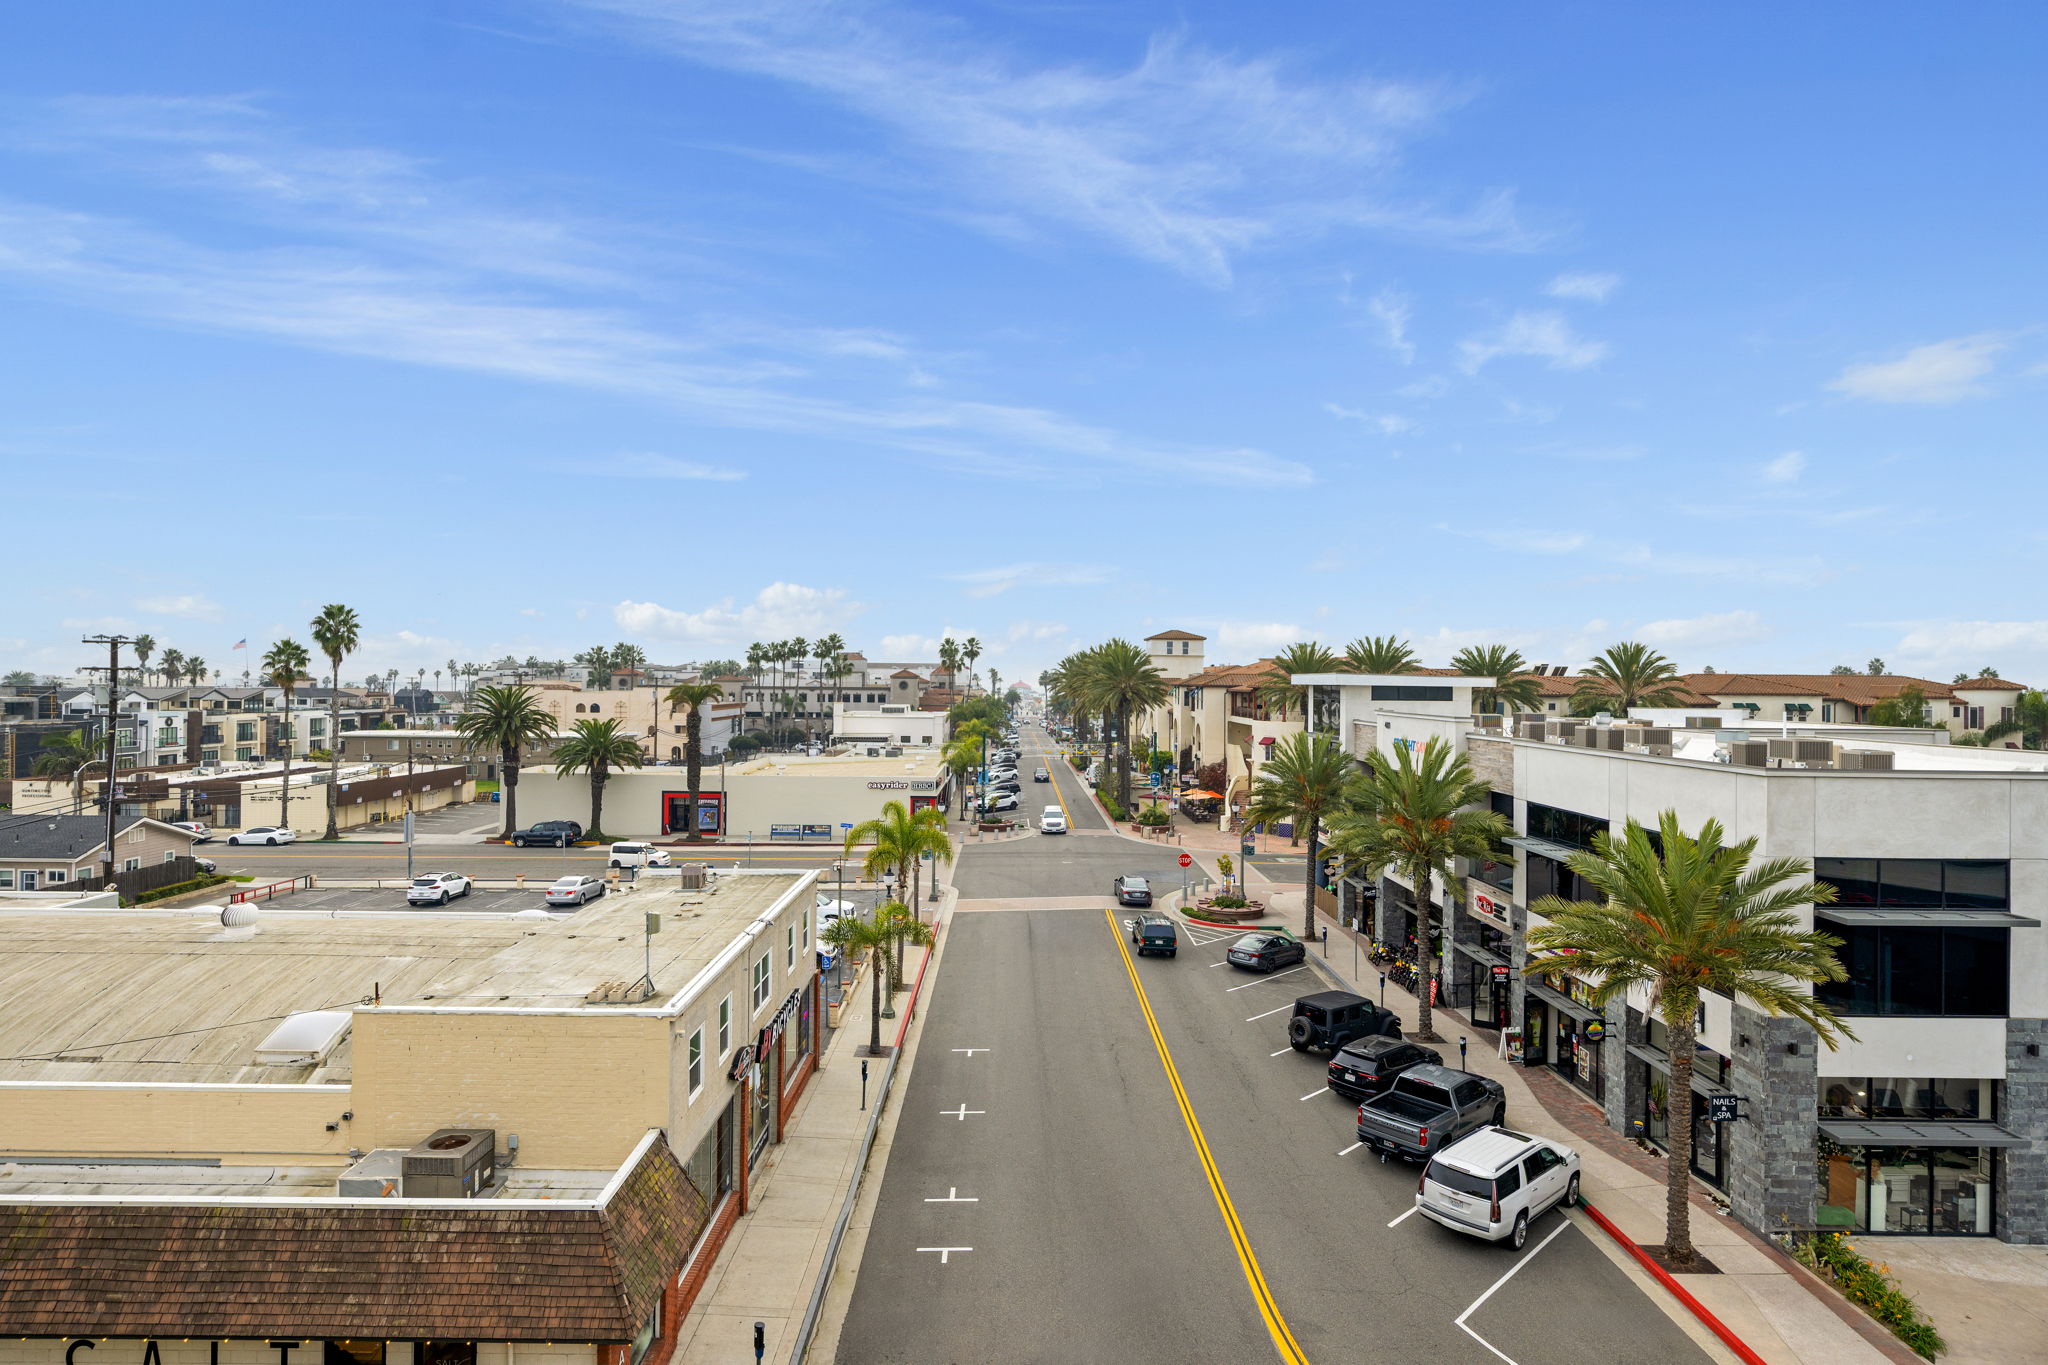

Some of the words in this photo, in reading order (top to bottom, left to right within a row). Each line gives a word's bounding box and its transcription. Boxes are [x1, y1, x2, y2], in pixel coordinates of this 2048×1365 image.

[867, 781, 908, 790] easyrider
[1713, 1098, 1736, 1106] NAILS
[1717, 1111, 1732, 1119] SPA
